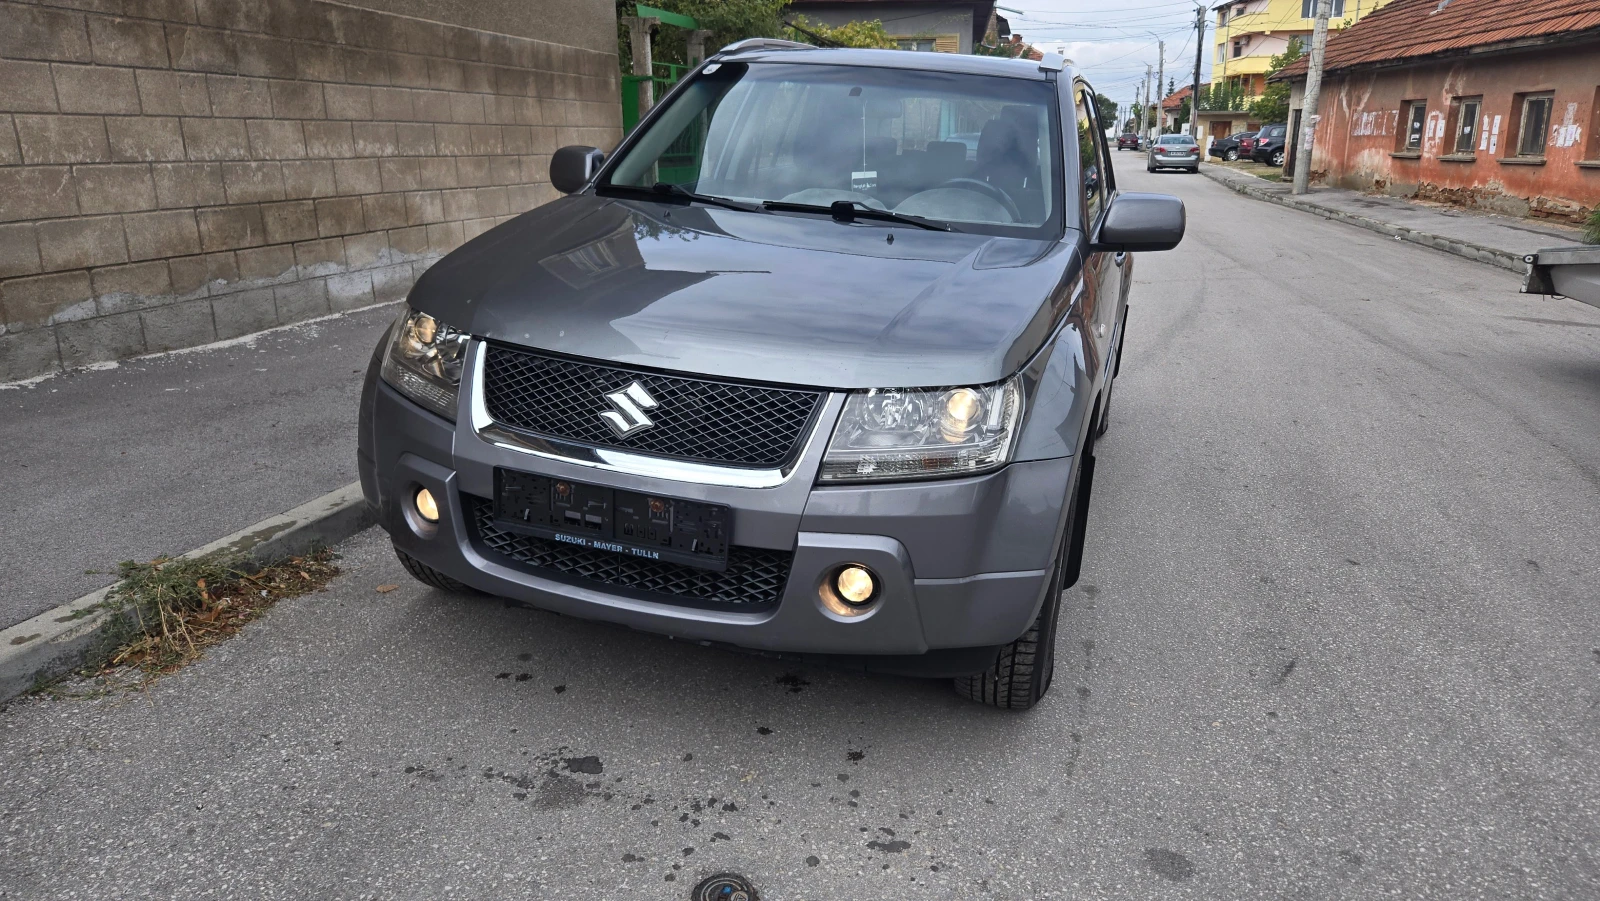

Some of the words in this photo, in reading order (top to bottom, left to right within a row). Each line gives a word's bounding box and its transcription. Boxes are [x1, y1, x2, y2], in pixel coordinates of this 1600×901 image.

[555, 533, 586, 546] SUZUKI
[593, 540, 623, 553] MAYER
[631, 547, 659, 560] TULLN
